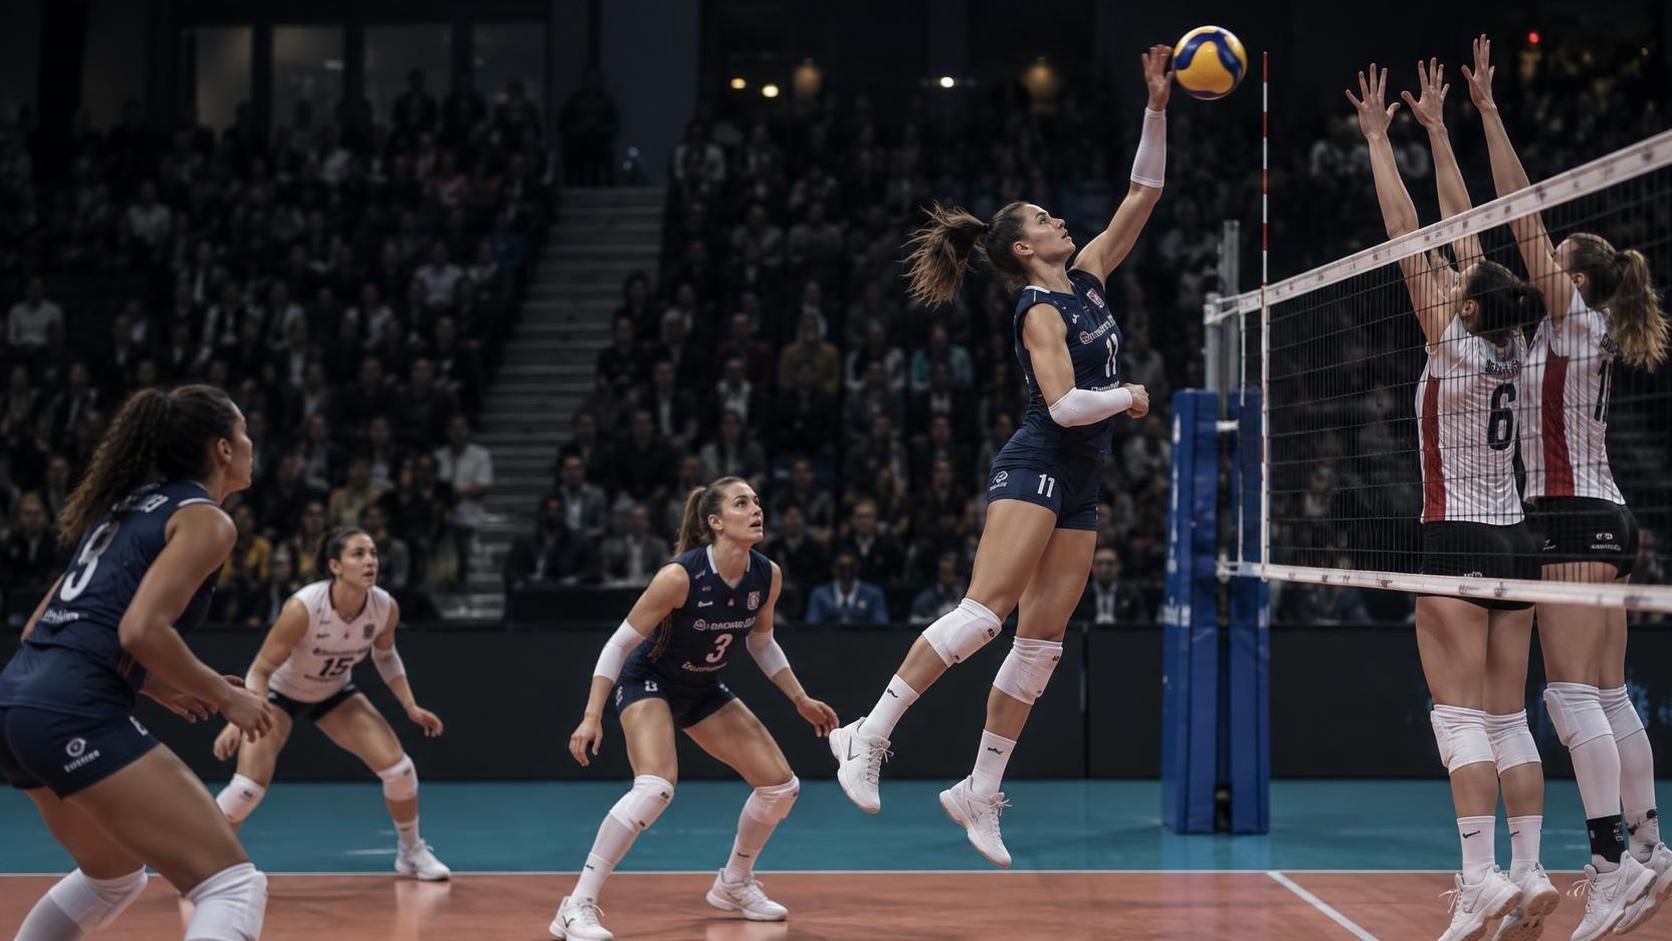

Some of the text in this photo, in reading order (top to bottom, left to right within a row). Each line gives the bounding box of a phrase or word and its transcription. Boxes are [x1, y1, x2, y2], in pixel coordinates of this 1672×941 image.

[1105, 332, 1119, 379] 11
[1487, 382, 1517, 451] 6
[1037, 473, 1056, 498] 11
[705, 633, 734, 663] 3
[319, 657, 353, 677] 15
